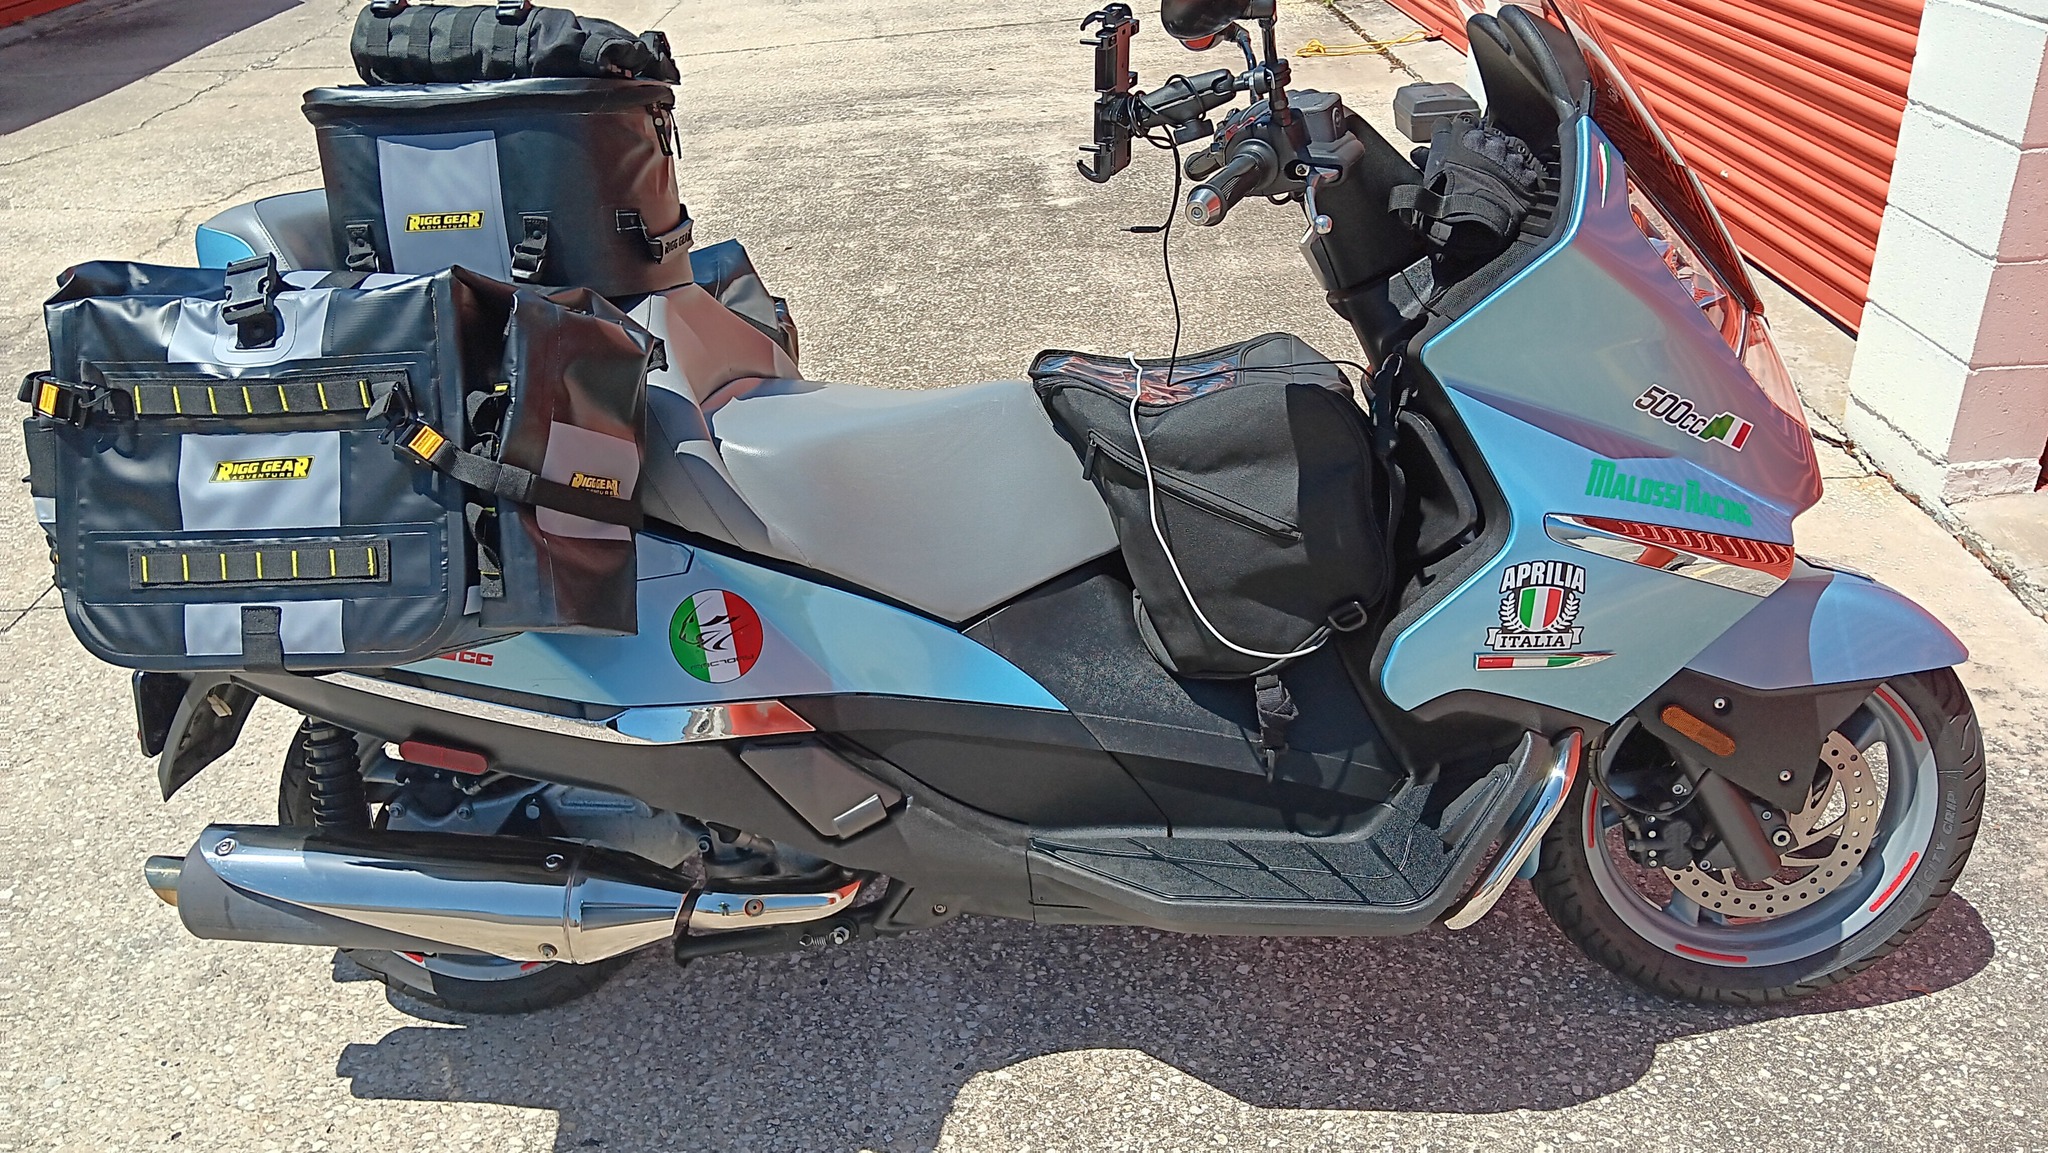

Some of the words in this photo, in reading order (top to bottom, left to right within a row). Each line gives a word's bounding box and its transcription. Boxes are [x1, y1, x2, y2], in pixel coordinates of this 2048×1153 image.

[409, 215, 441, 231] RIGG
[443, 212, 480, 228] GEAR
[1634, 385, 1708, 435] 500cc
[216, 462, 260, 481] RIGG
[261, 457, 309, 477] GEAR
[231, 472, 292, 480] ADVENTURE
[1585, 458, 1684, 511] MALOSSI
[1685, 479, 1753, 527] RACING
[1500, 561, 1586, 594] APRILIA
[1500, 635, 1566, 648] ITALIA
[1923, 842, 1947, 883] CITY
[1942, 791, 1958, 835] GRIP
